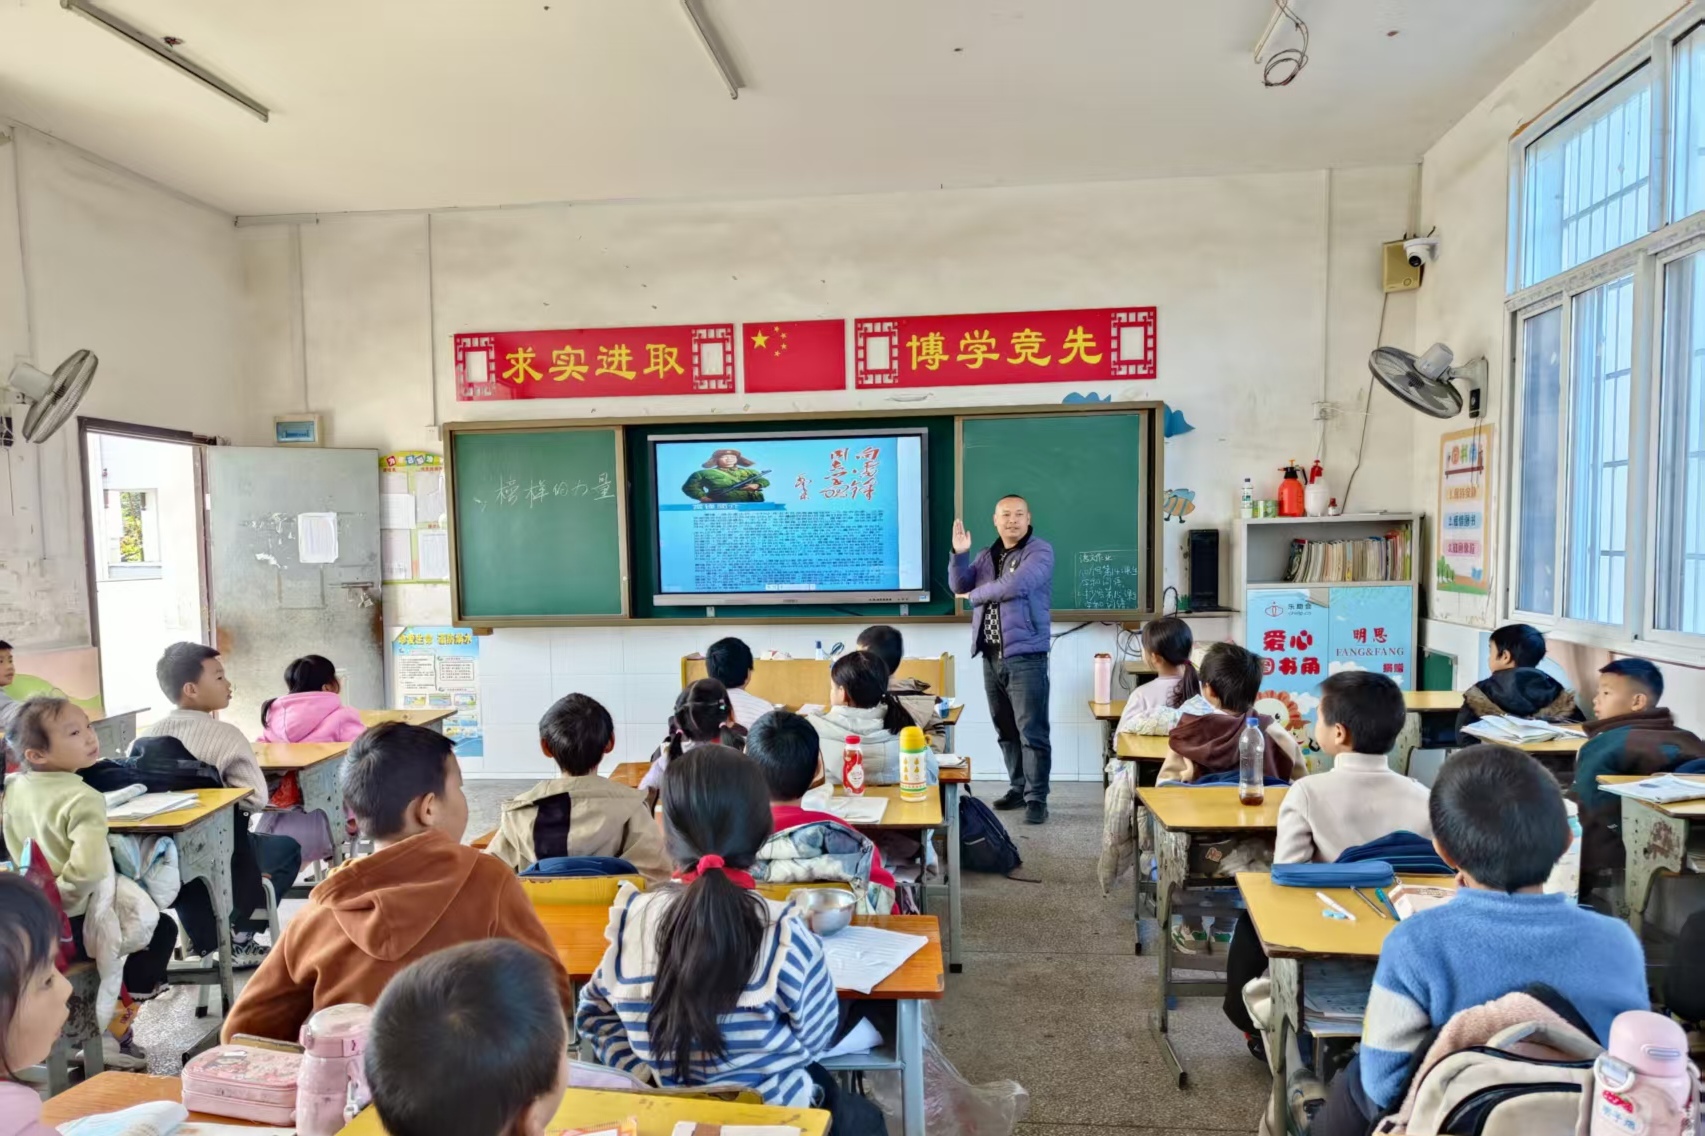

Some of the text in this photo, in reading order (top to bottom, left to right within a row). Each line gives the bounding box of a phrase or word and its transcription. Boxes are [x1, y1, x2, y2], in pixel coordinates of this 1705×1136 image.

[502, 343, 685, 385] 求实进取
[905, 325, 1103, 372] 博学竞先
[495, 472, 616, 509] 榜样的力量
[1263, 629, 1313, 652] 爱心
[1336, 647, 1404, 657] FANG&FANG
